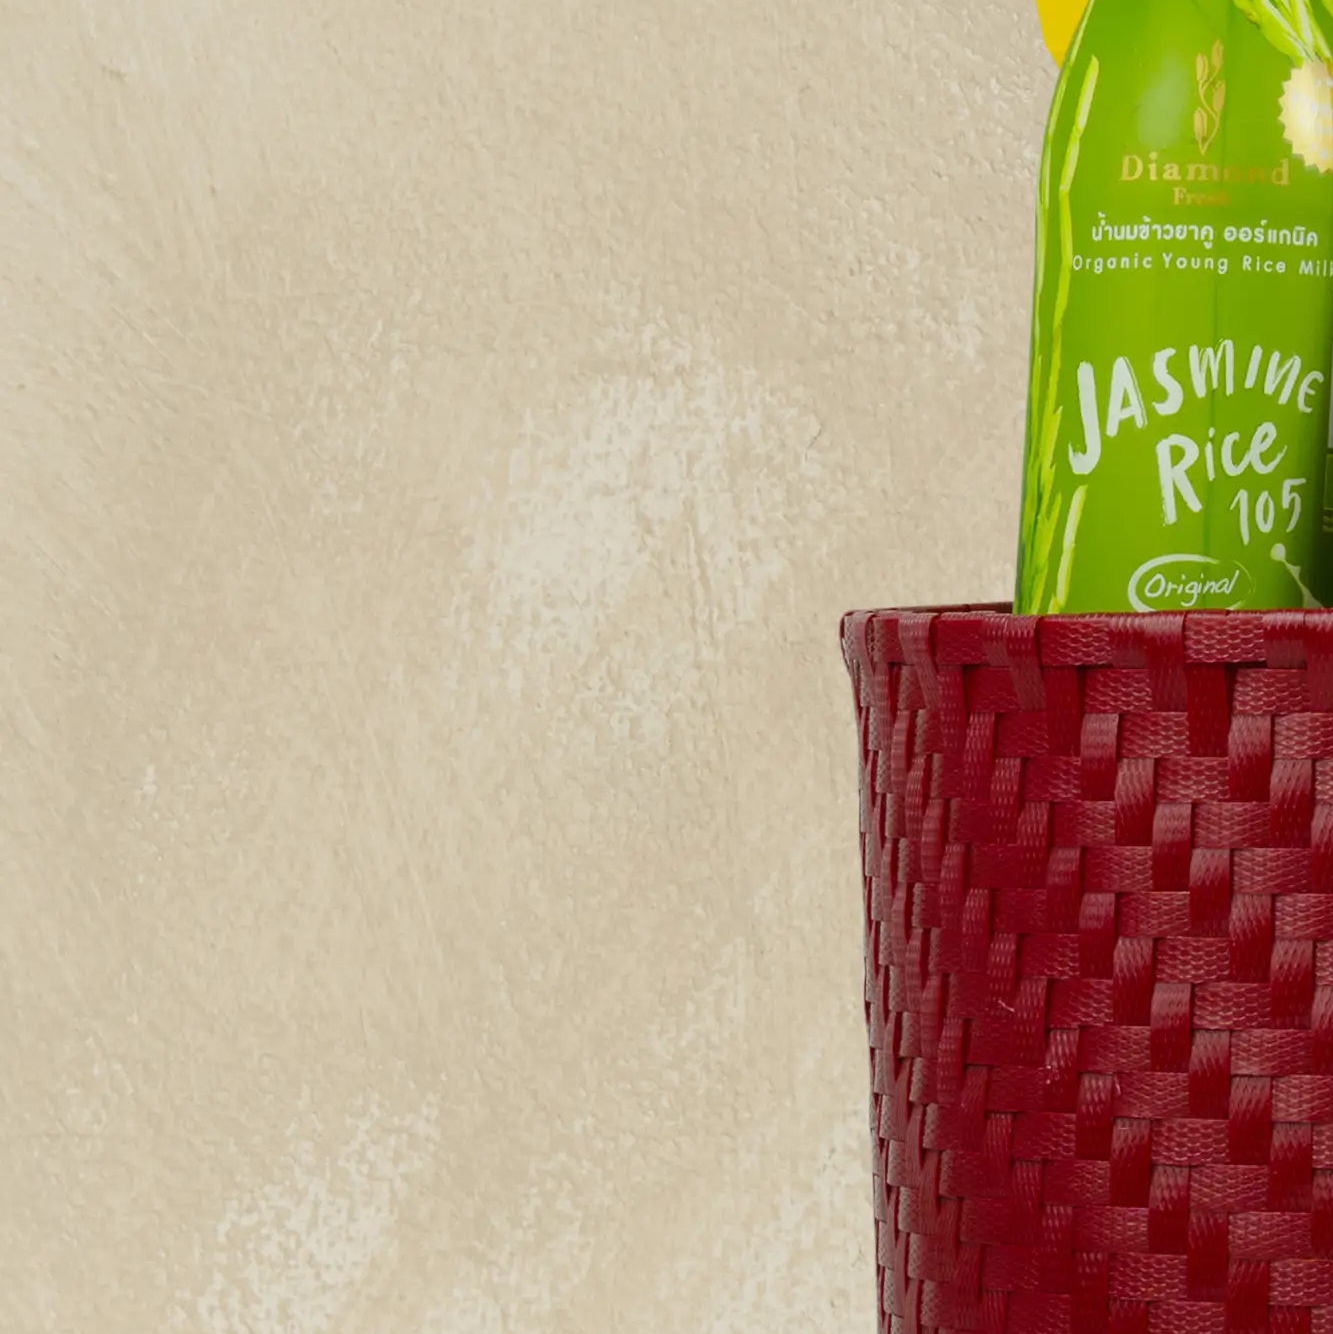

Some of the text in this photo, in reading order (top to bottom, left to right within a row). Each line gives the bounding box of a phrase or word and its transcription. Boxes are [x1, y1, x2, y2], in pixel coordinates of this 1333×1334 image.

[1119, 152, 1291, 186] Diamond
[1091, 211, 1318, 249] น้ำนมข้าวยาคู ออร์แกนิค
[1072, 253, 1153, 275] Organic
[1162, 253, 1229, 275] Young
[1243, 255, 1286, 273] Rice
[1155, 421, 1288, 527] Rice
[1230, 477, 1306, 546] 105
[1144, 568, 1241, 608] Original
